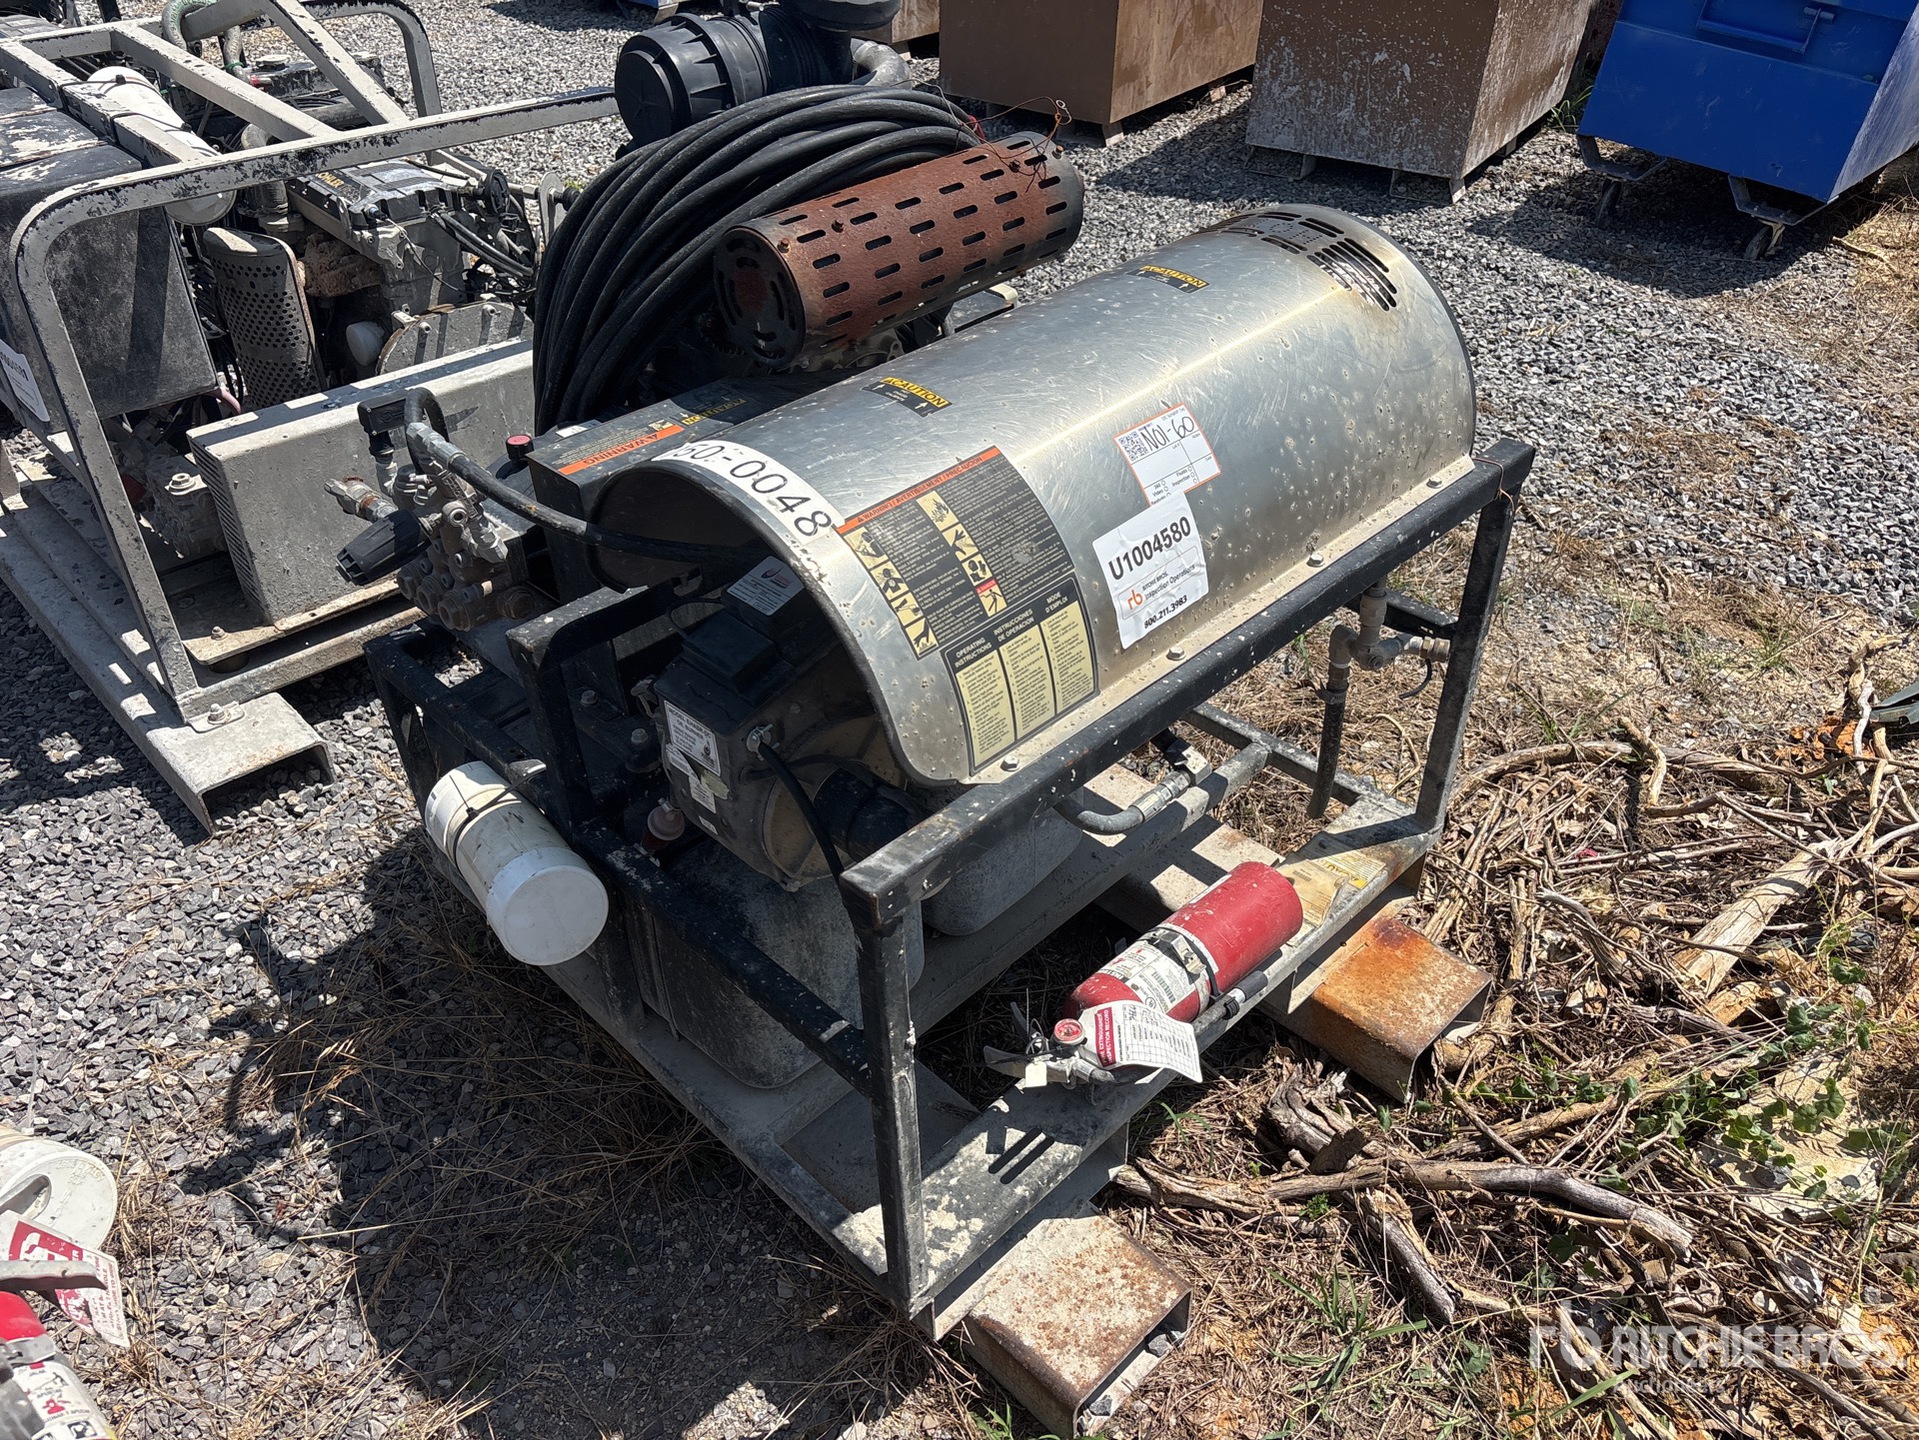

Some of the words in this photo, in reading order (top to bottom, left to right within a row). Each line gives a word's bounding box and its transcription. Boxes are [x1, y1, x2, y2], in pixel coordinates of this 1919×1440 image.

[1151, 266, 1205, 287] CAUTION
[893, 379, 947, 406] CAUTION
[582, 437, 646, 465] WARNING
[863, 502, 894, 523] WARNING
[1108, 516, 1191, 580] U1004580
[1144, 578, 1170, 601] Inspection
[1169, 563, 1196, 585] Operations
[1044, 596, 1068, 613] D'EMPLOI
[1046, 590, 1062, 604] MODE
[993, 608, 1034, 636] INSTRUCCIONES
[1144, 594, 1188, 629] 800.211.3983
[954, 641, 993, 668] INSTRUCTIONS
[955, 636, 986, 658] OPERATING
[1105, 1029, 1113, 1063] INSPECTION
